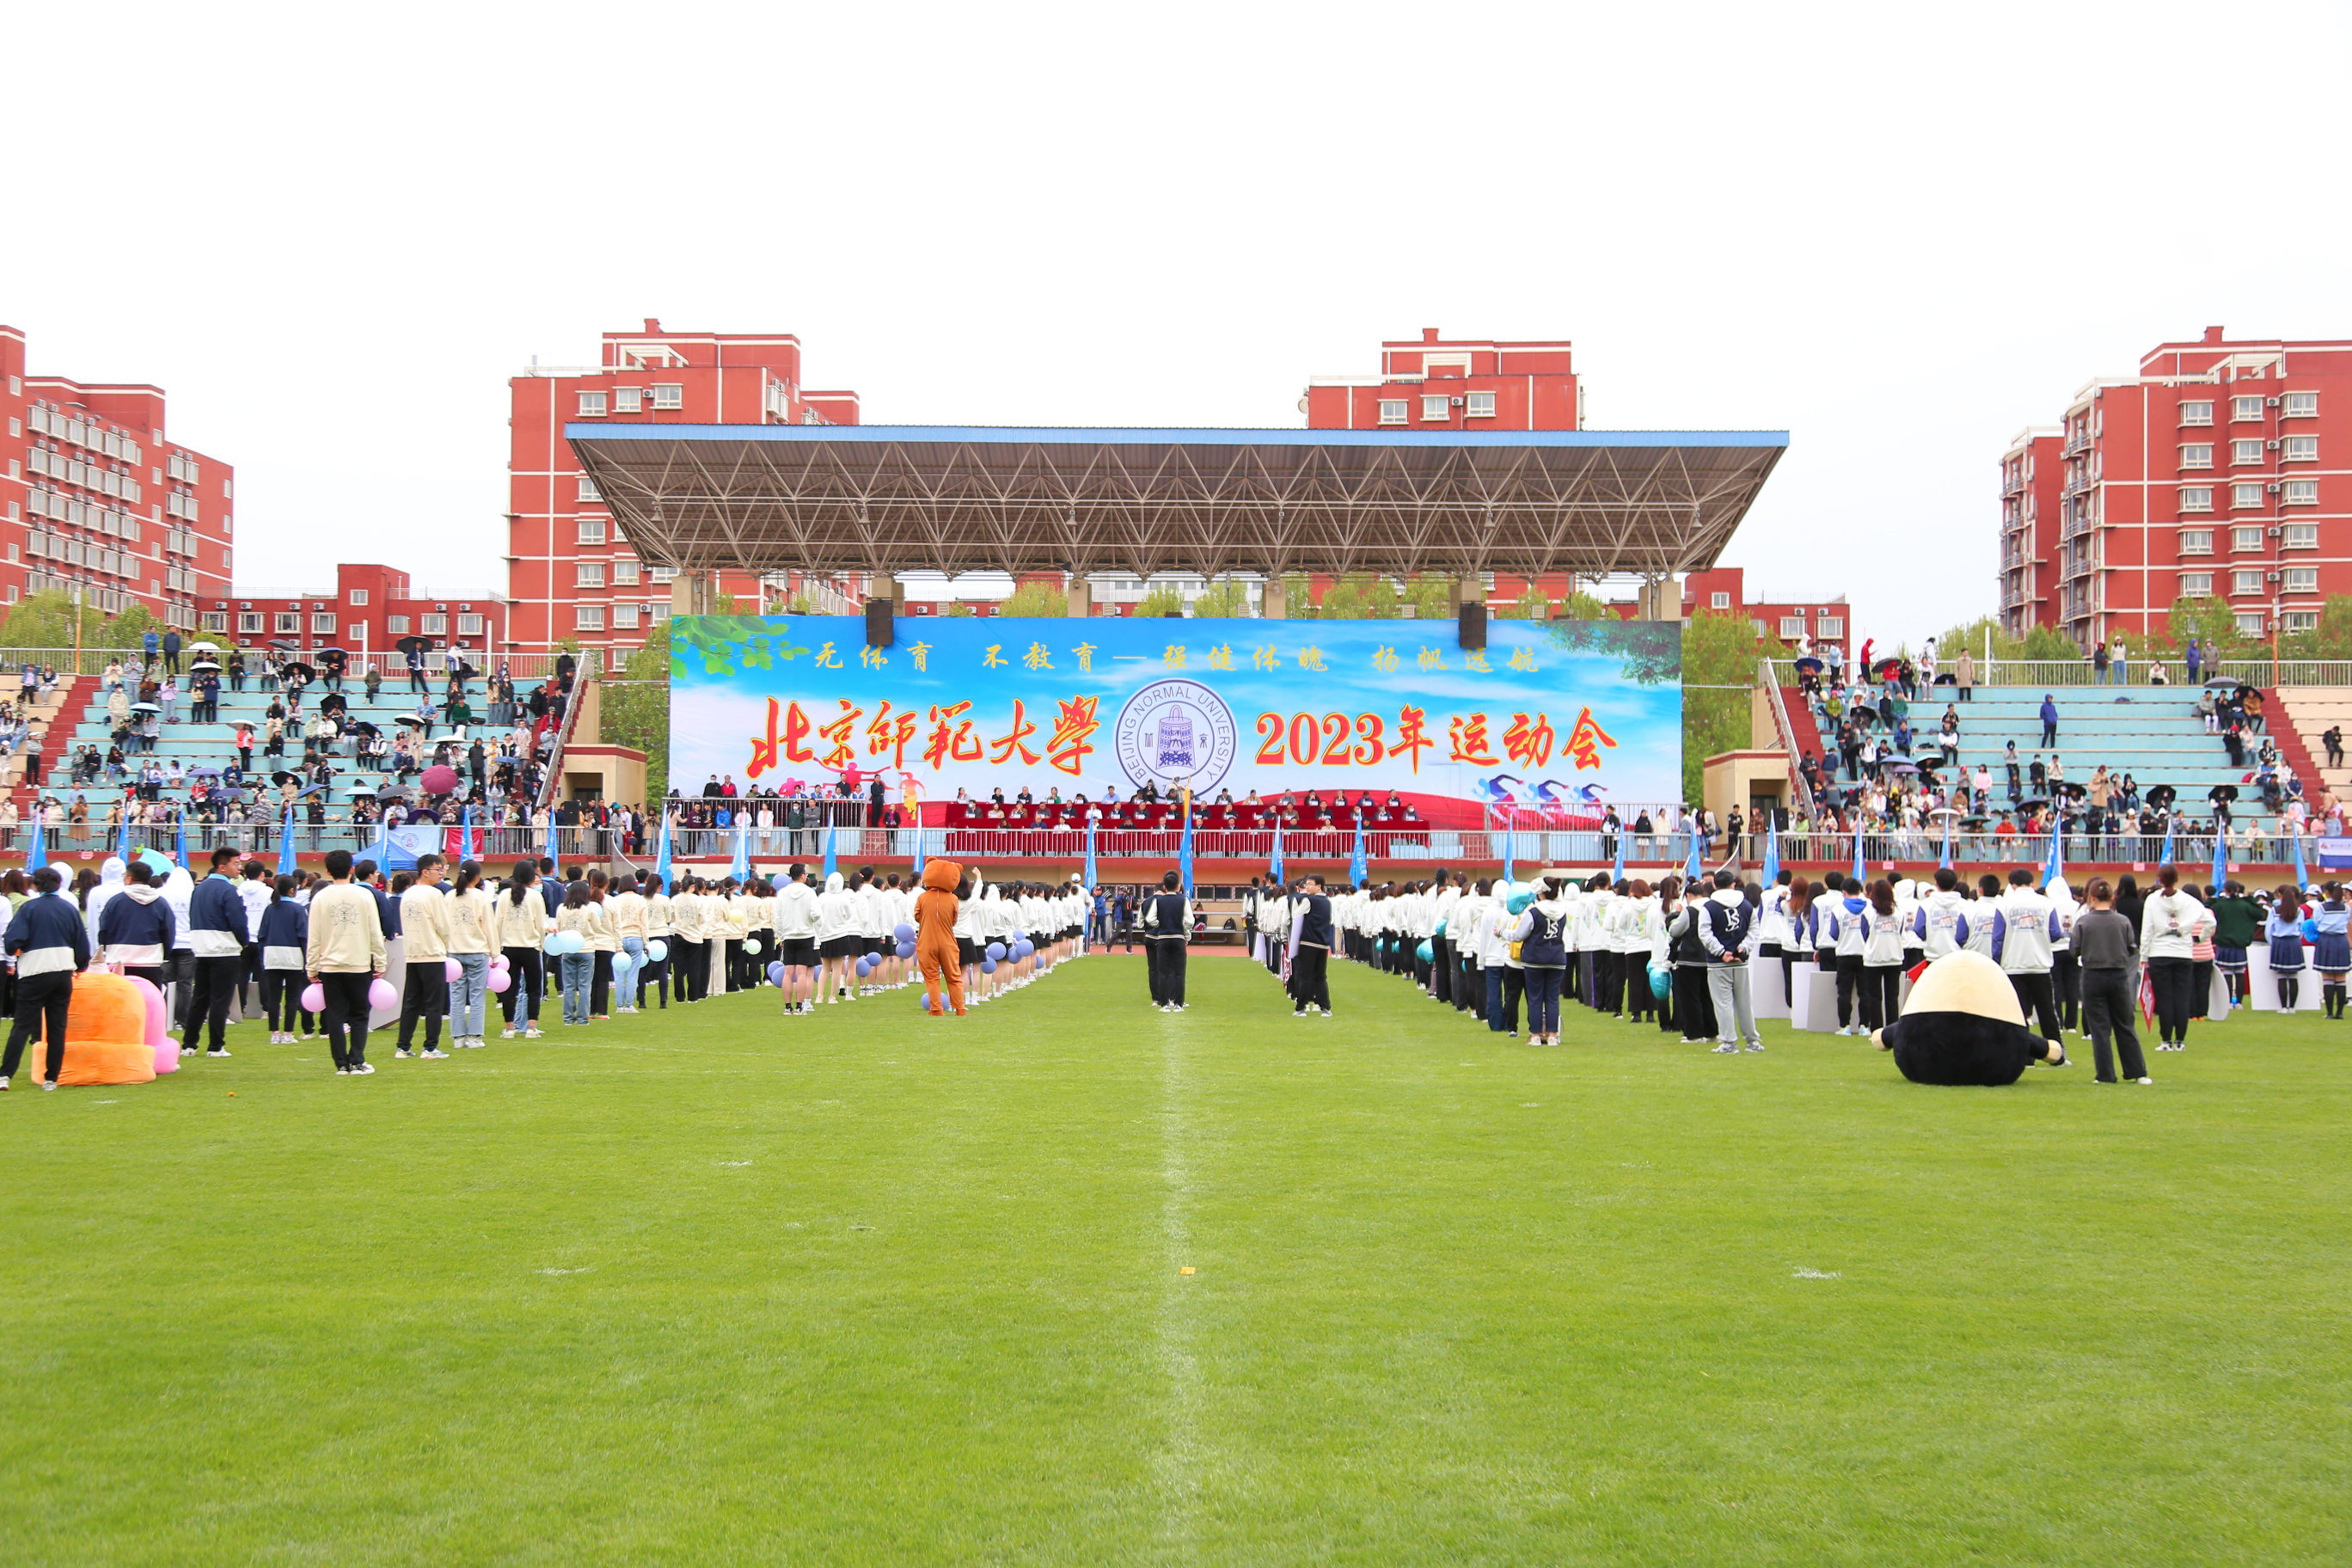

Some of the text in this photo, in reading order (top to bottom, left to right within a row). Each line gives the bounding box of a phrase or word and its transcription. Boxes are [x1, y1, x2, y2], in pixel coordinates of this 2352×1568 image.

[1373, 644, 1539, 672] 扬帆远航
[1123, 686, 1230, 781] BEIJING NORMAL UNIVERSITY
[1254, 702, 1618, 775] 2023年运动会
